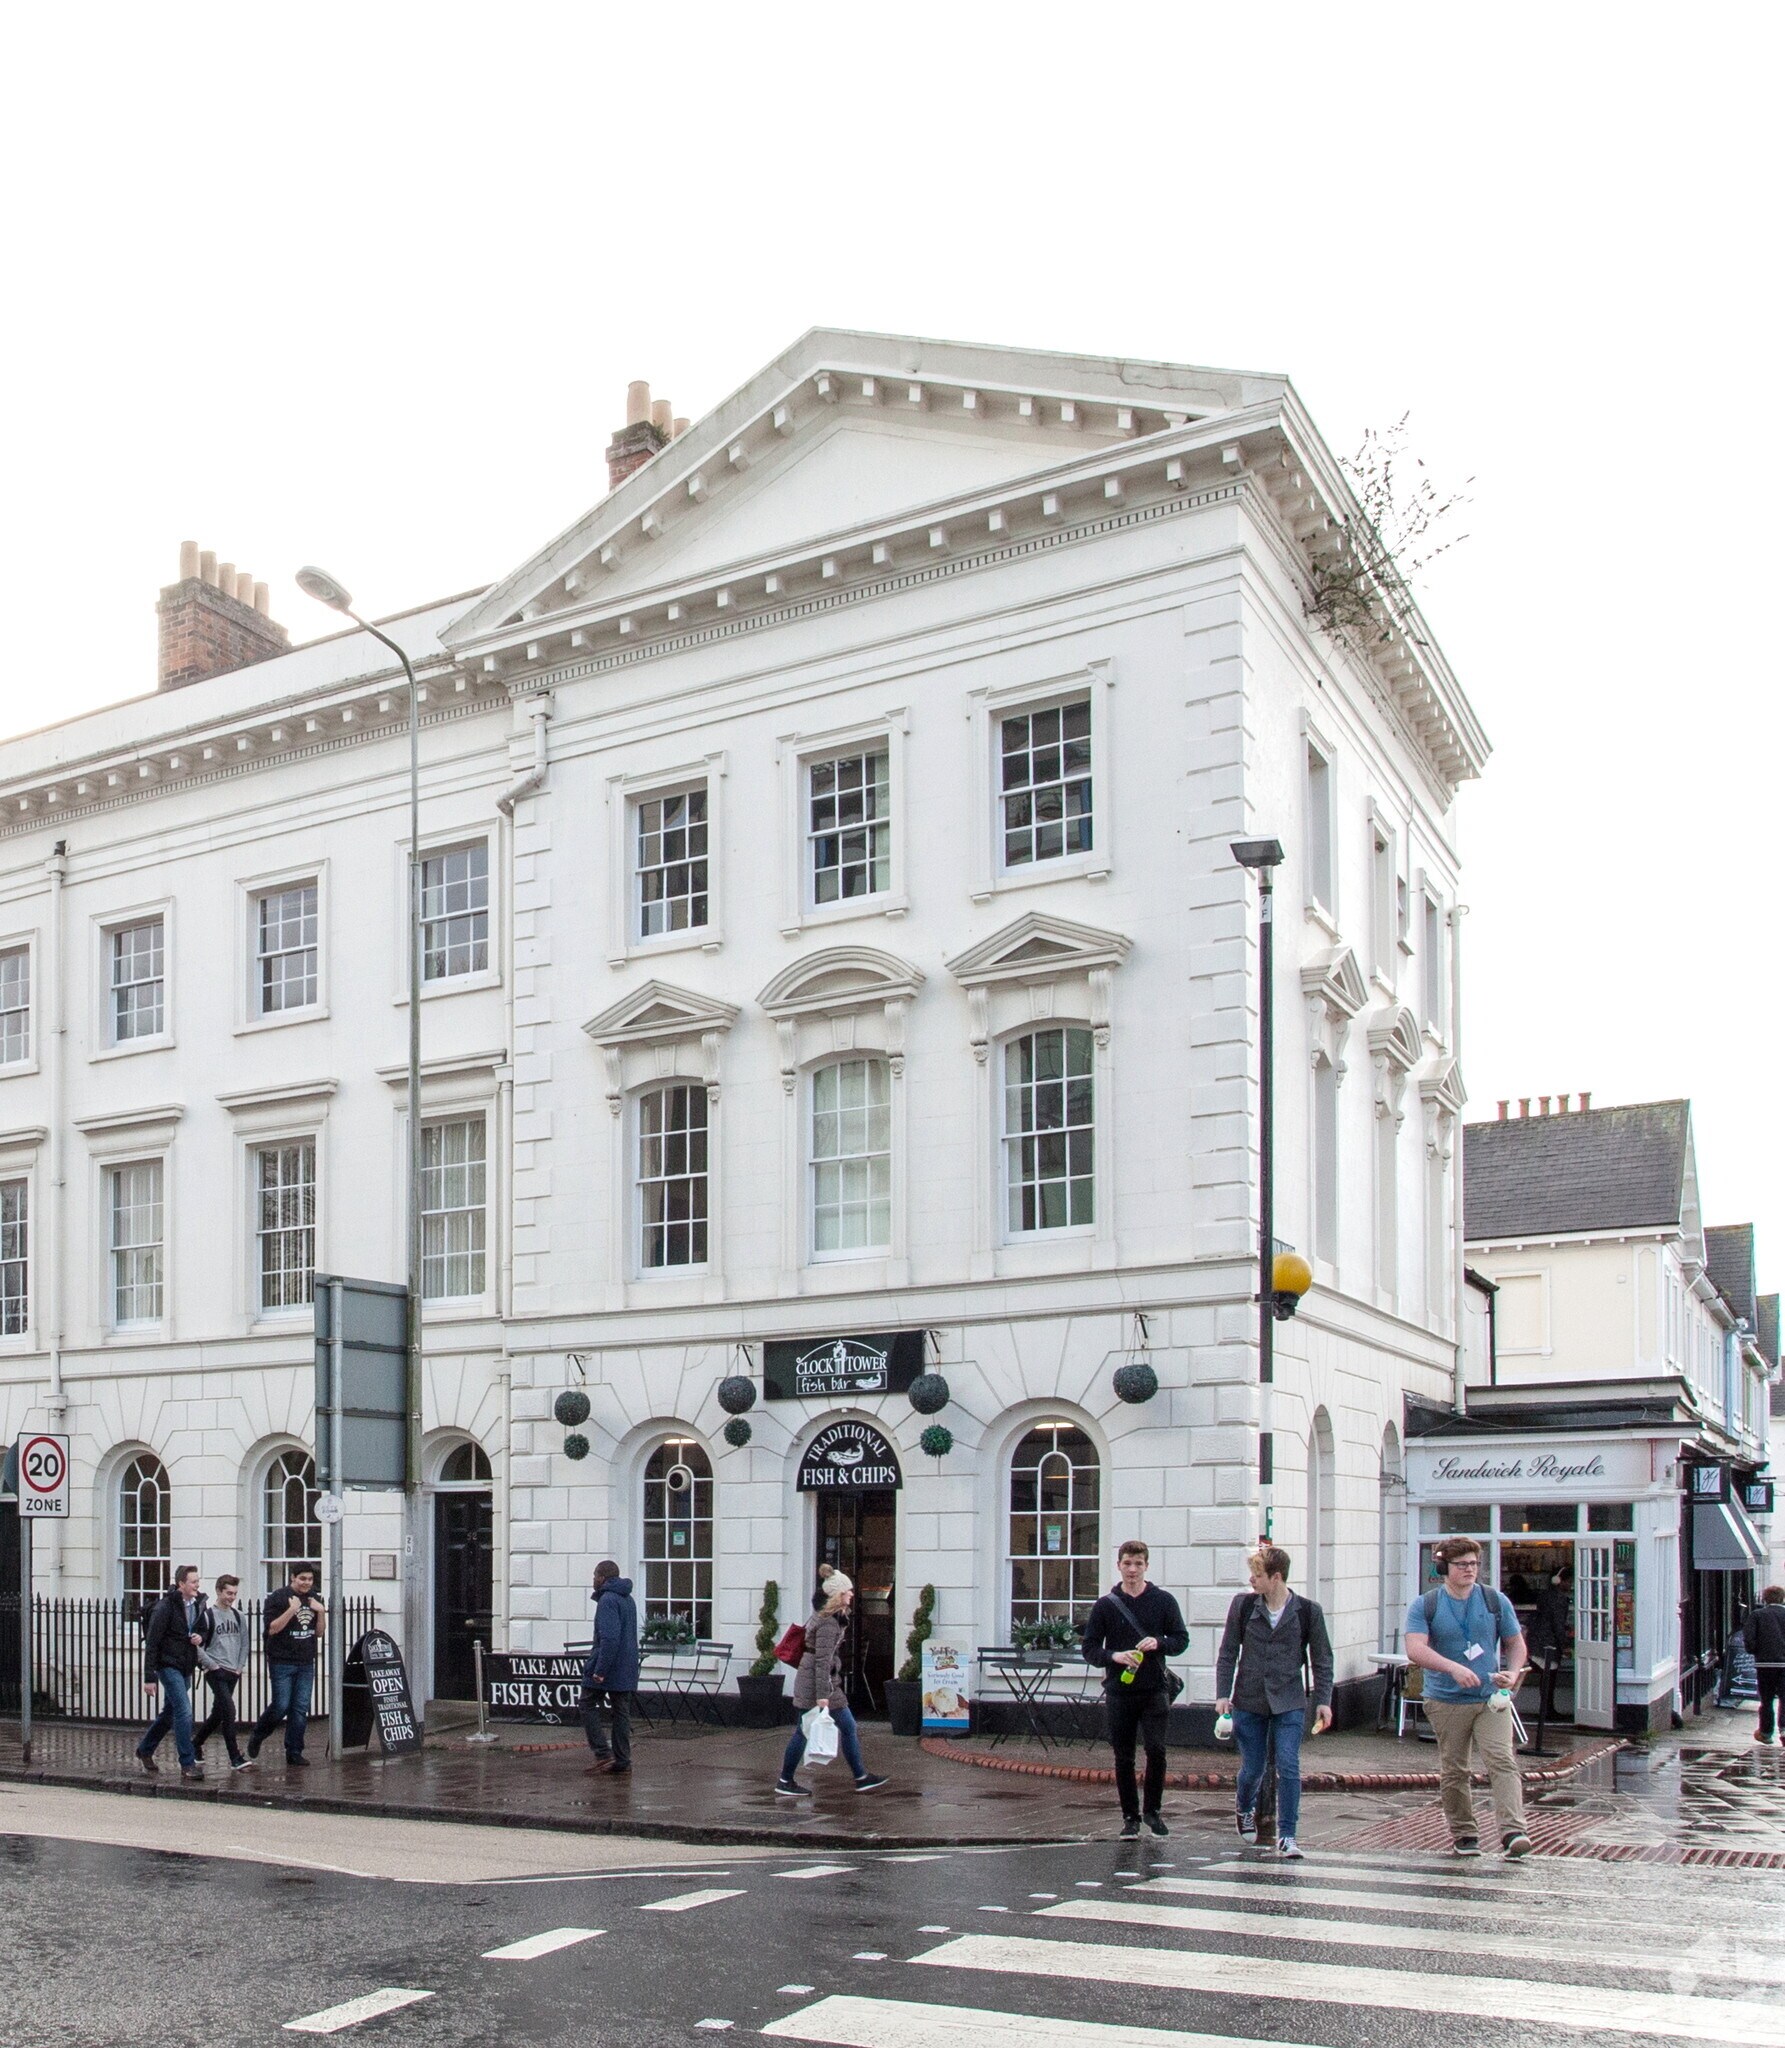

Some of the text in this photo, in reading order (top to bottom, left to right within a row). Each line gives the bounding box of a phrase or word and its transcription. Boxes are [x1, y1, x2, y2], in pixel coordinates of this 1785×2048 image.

[796, 1356, 887, 1375] CLOCK TOWER
[801, 1377, 852, 1392] fish bar
[807, 1424, 888, 1462] TRADITIONAL
[29, 1453, 59, 1477] 20
[1432, 1454, 1604, 1482] Sandwich Royale
[803, 1465, 896, 1486] FISH & CHIPS
[26, 1498, 62, 1511] ZONE
[509, 1658, 548, 1675] TAKE
[373, 1677, 404, 1693] OPEN
[491, 1683, 534, 1706] FISH
[538, 1684, 552, 1707] &
[380, 1711, 411, 1727] FISH &
[384, 1725, 414, 1742] CHIPS
